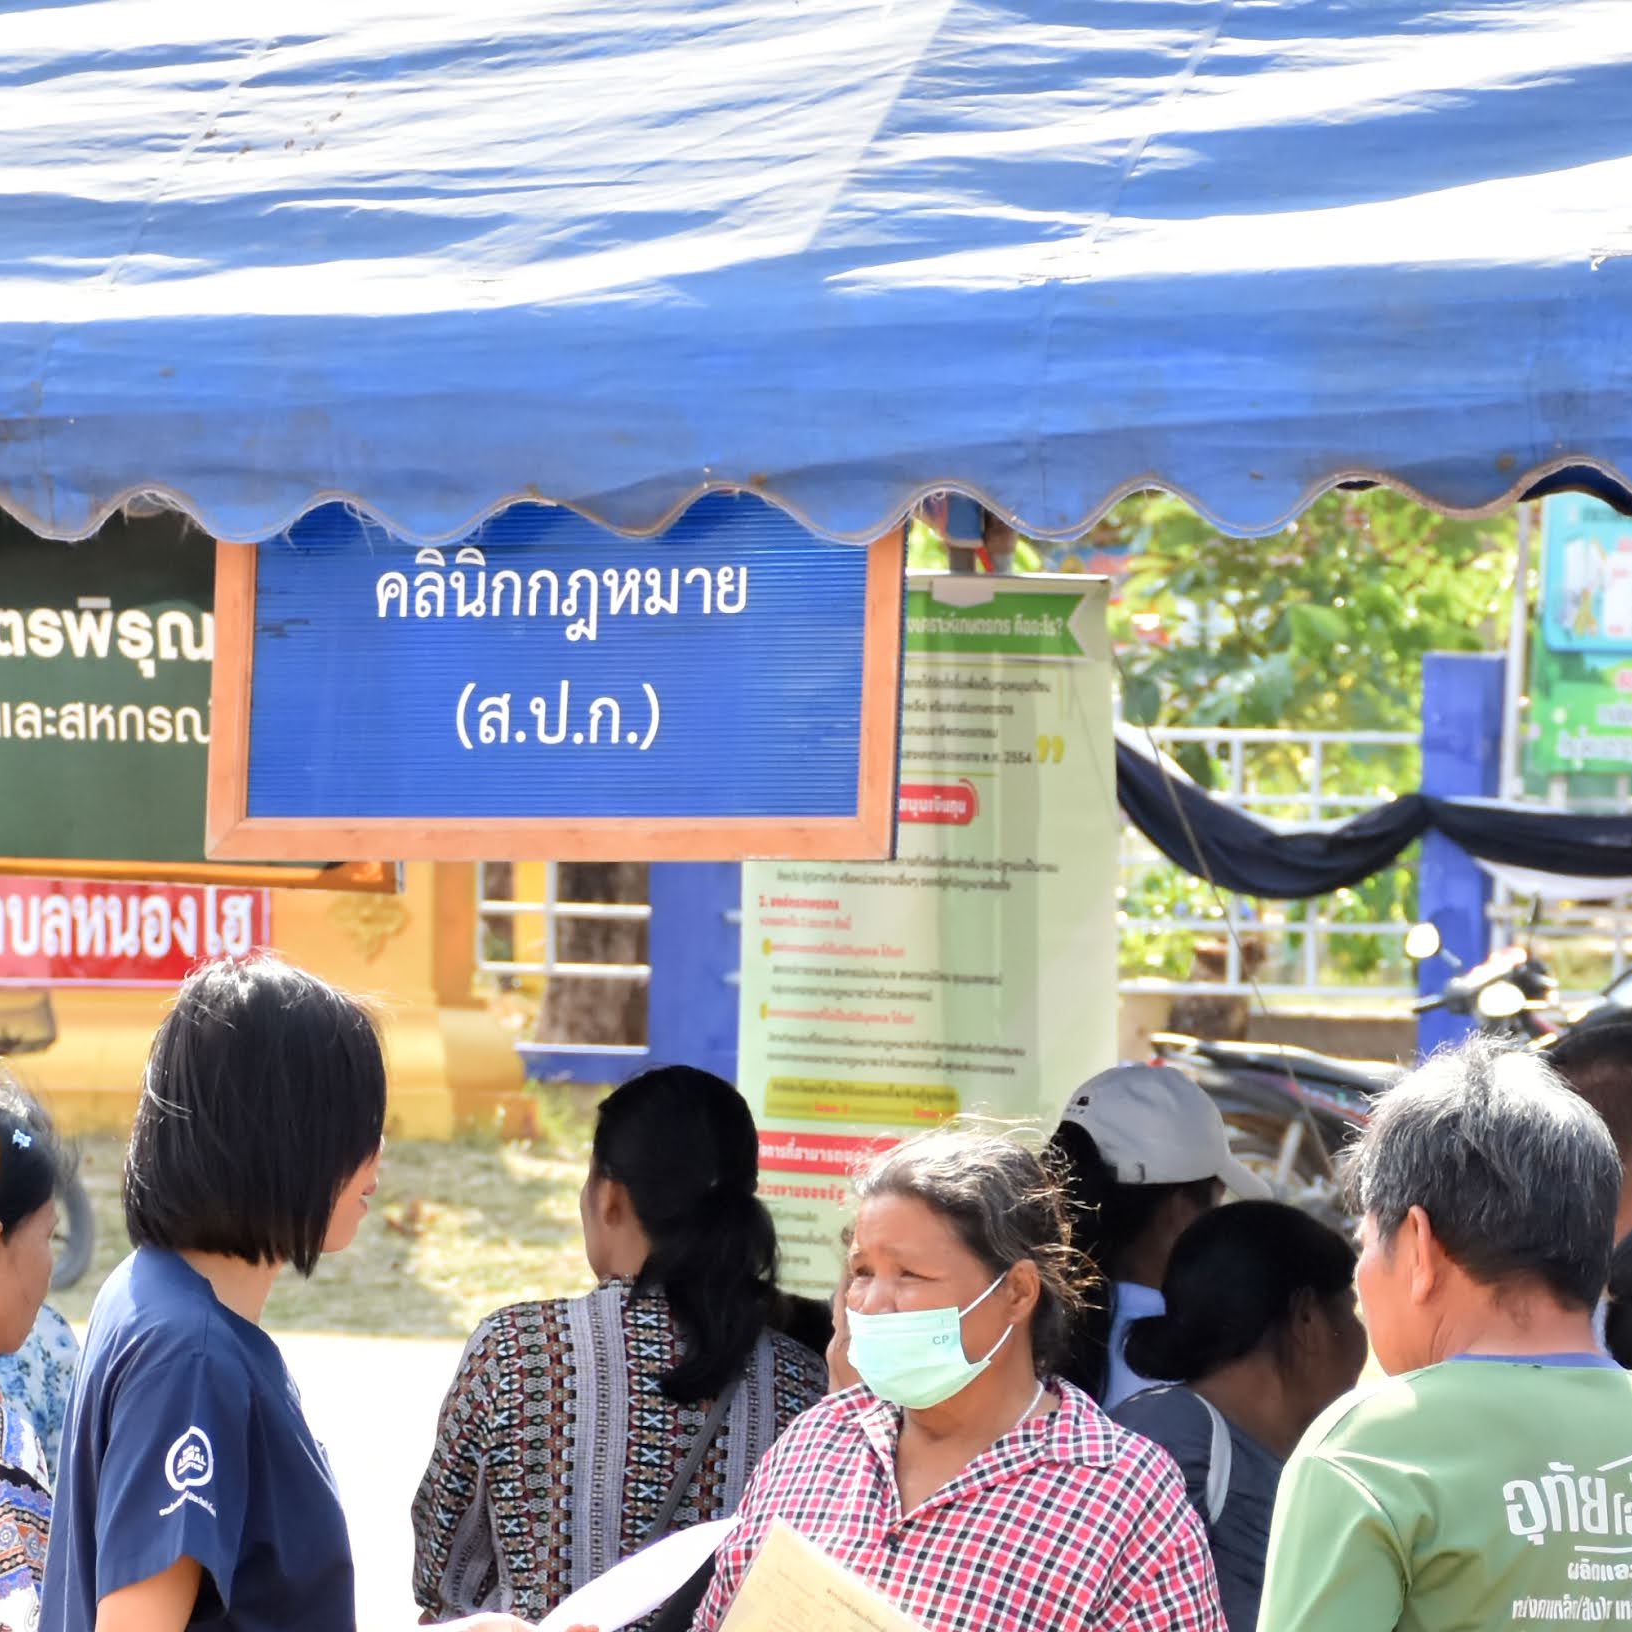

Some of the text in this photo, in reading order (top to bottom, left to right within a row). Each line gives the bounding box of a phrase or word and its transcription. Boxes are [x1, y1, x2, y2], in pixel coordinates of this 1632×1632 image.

[375, 546, 751, 643] คลินิกกฎหมาย
[455, 678, 662, 751] (ส.ป.ก.)
